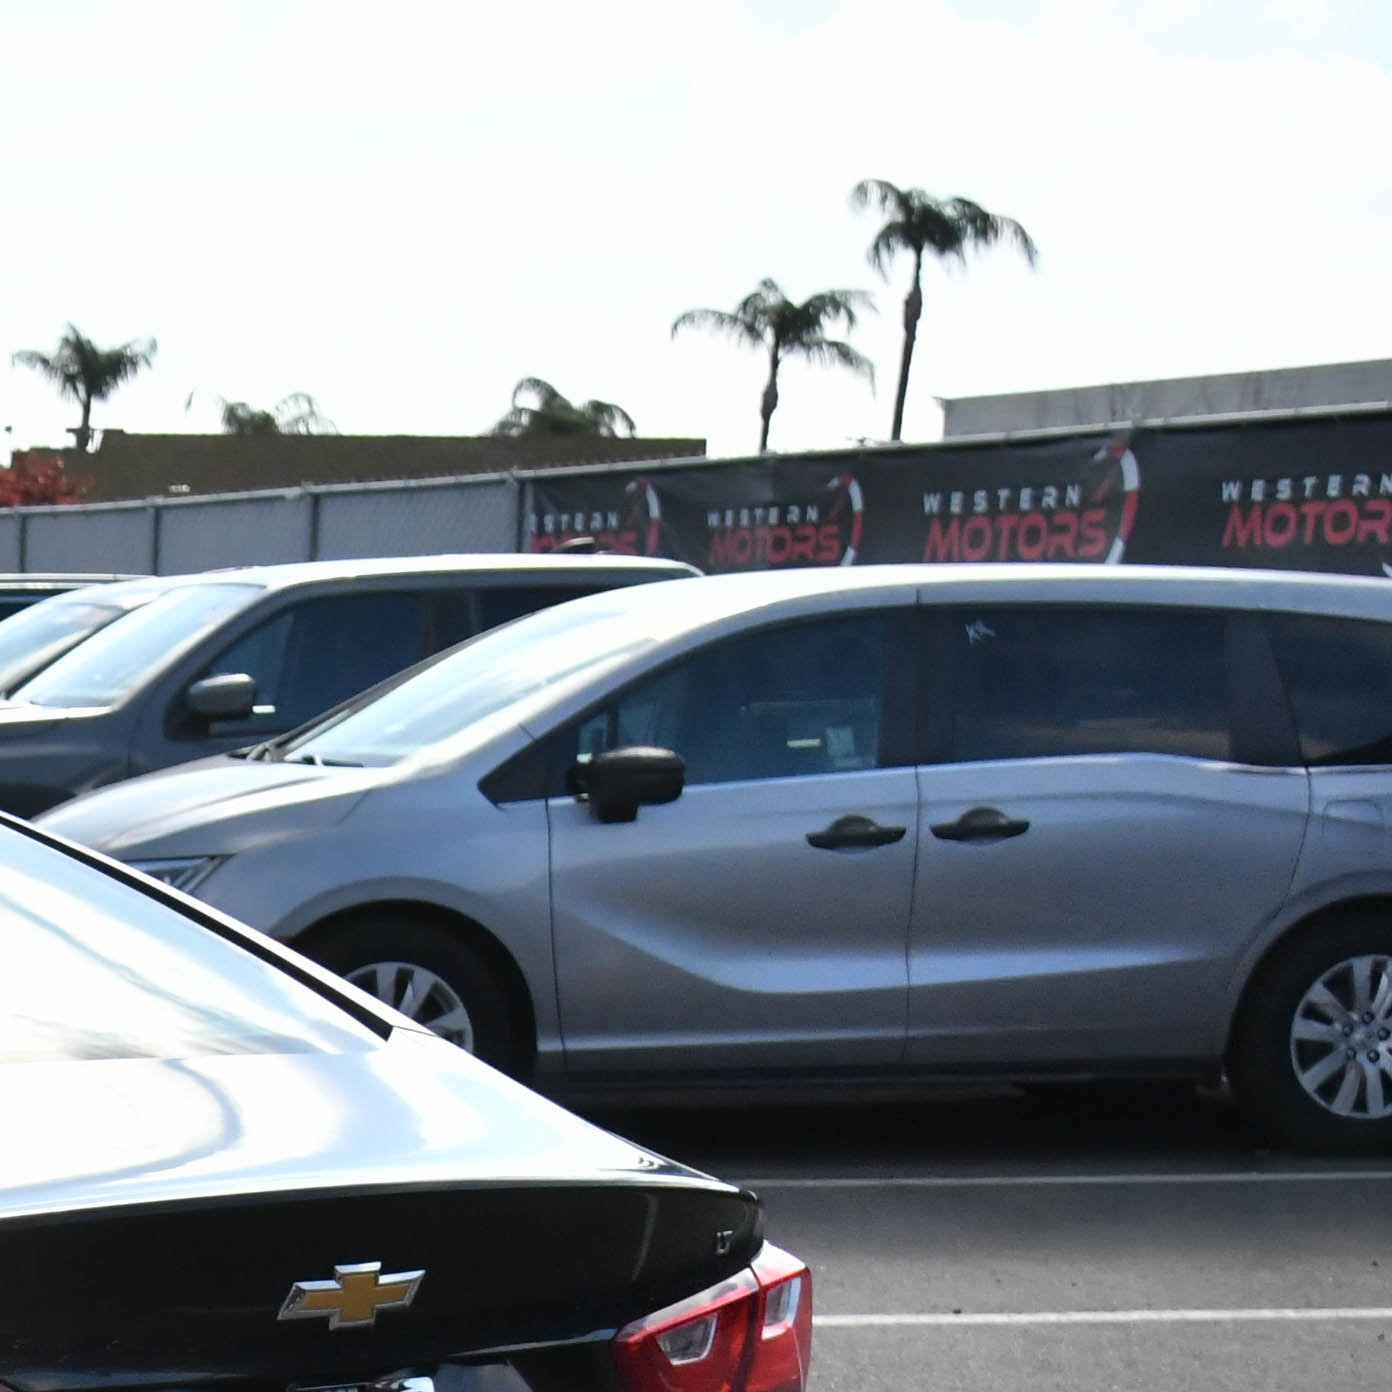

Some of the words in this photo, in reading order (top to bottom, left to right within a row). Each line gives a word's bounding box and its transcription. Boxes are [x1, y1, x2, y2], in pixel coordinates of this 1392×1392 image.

[923, 484, 1082, 515] WESTERN
[1221, 472, 1392, 503] WESTERN
[707, 504, 819, 528] WESTERN
[711, 523, 841, 566] MOTORS
[923, 509, 1108, 562] MOTORS
